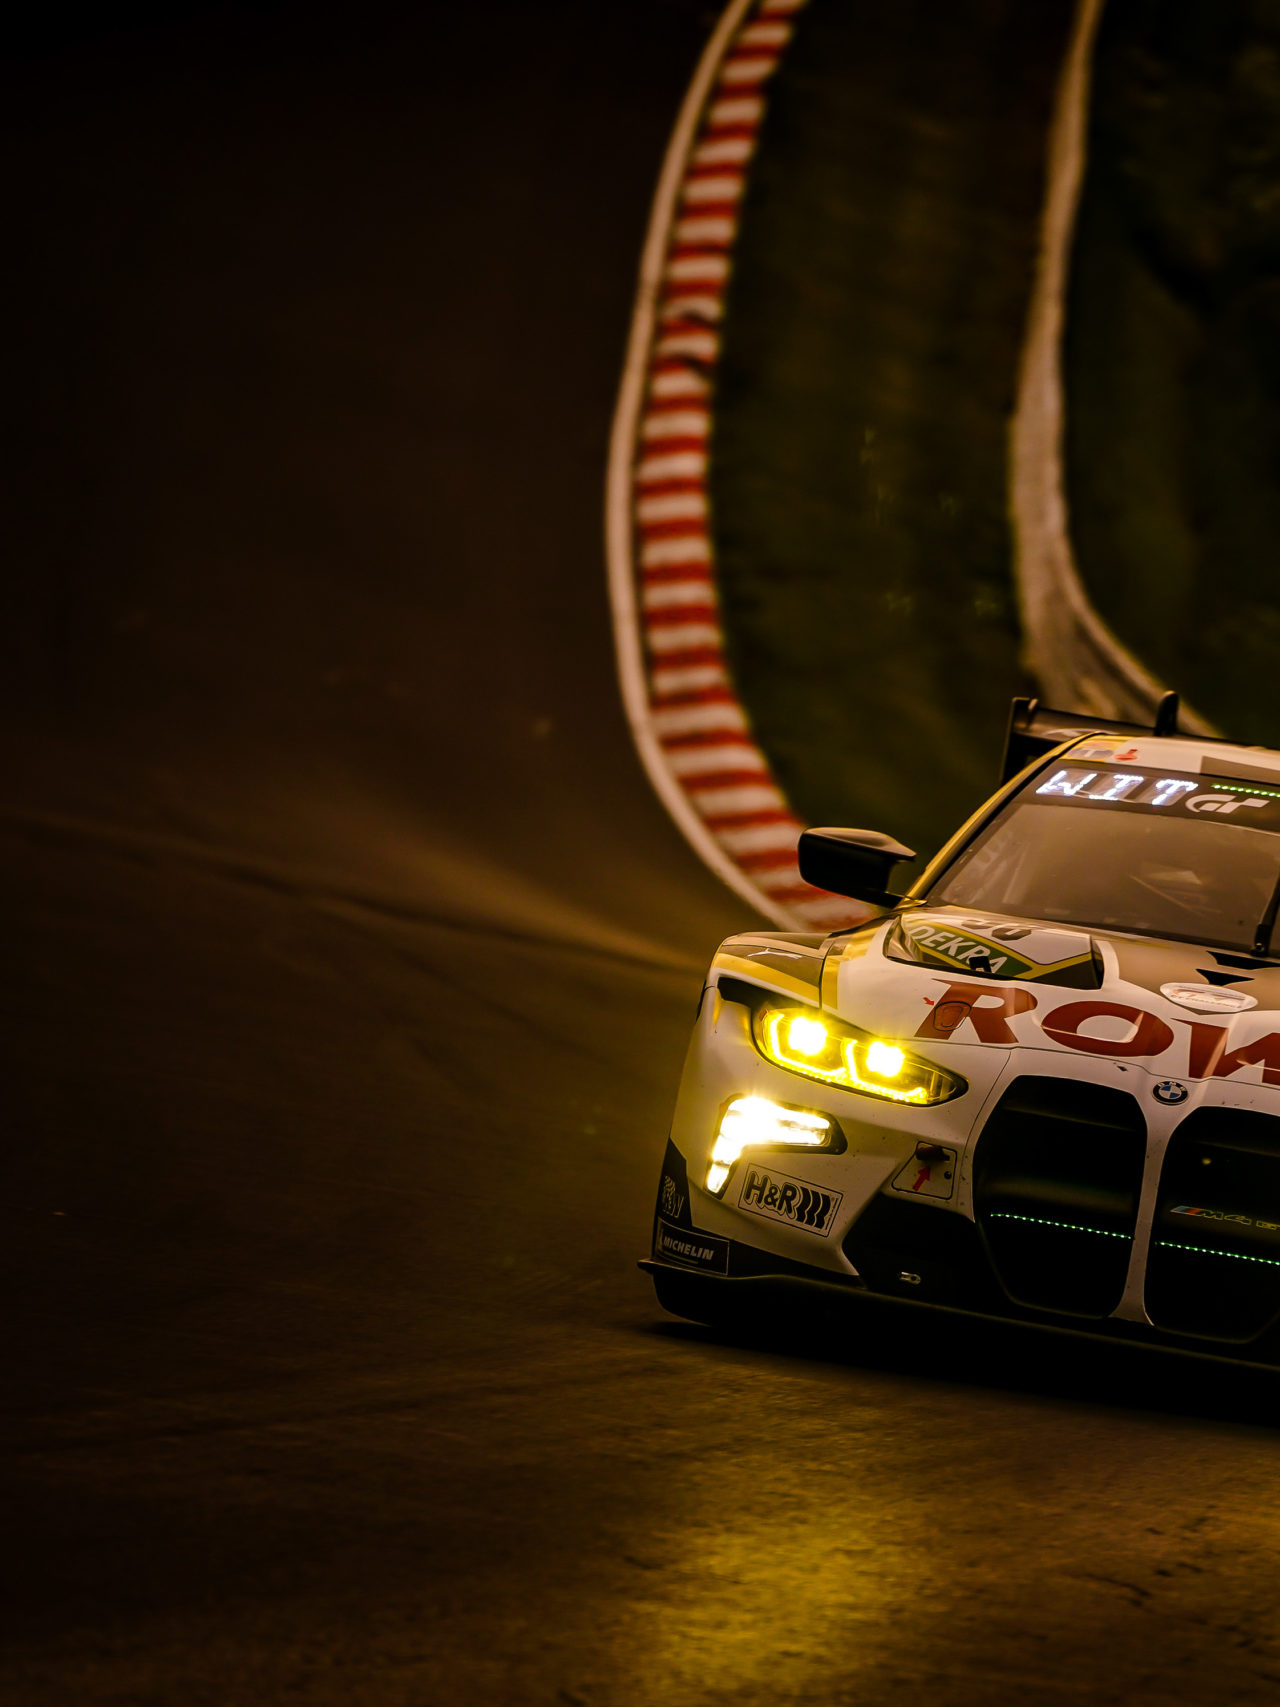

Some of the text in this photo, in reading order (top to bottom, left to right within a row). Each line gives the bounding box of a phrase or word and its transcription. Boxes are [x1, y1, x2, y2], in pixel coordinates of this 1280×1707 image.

[1036, 770, 1199, 806] WIT
[908, 926, 1008, 974] DEKRA
[745, 1172, 798, 1217] H&R
[663, 1235, 715, 1261] MICHELIN
